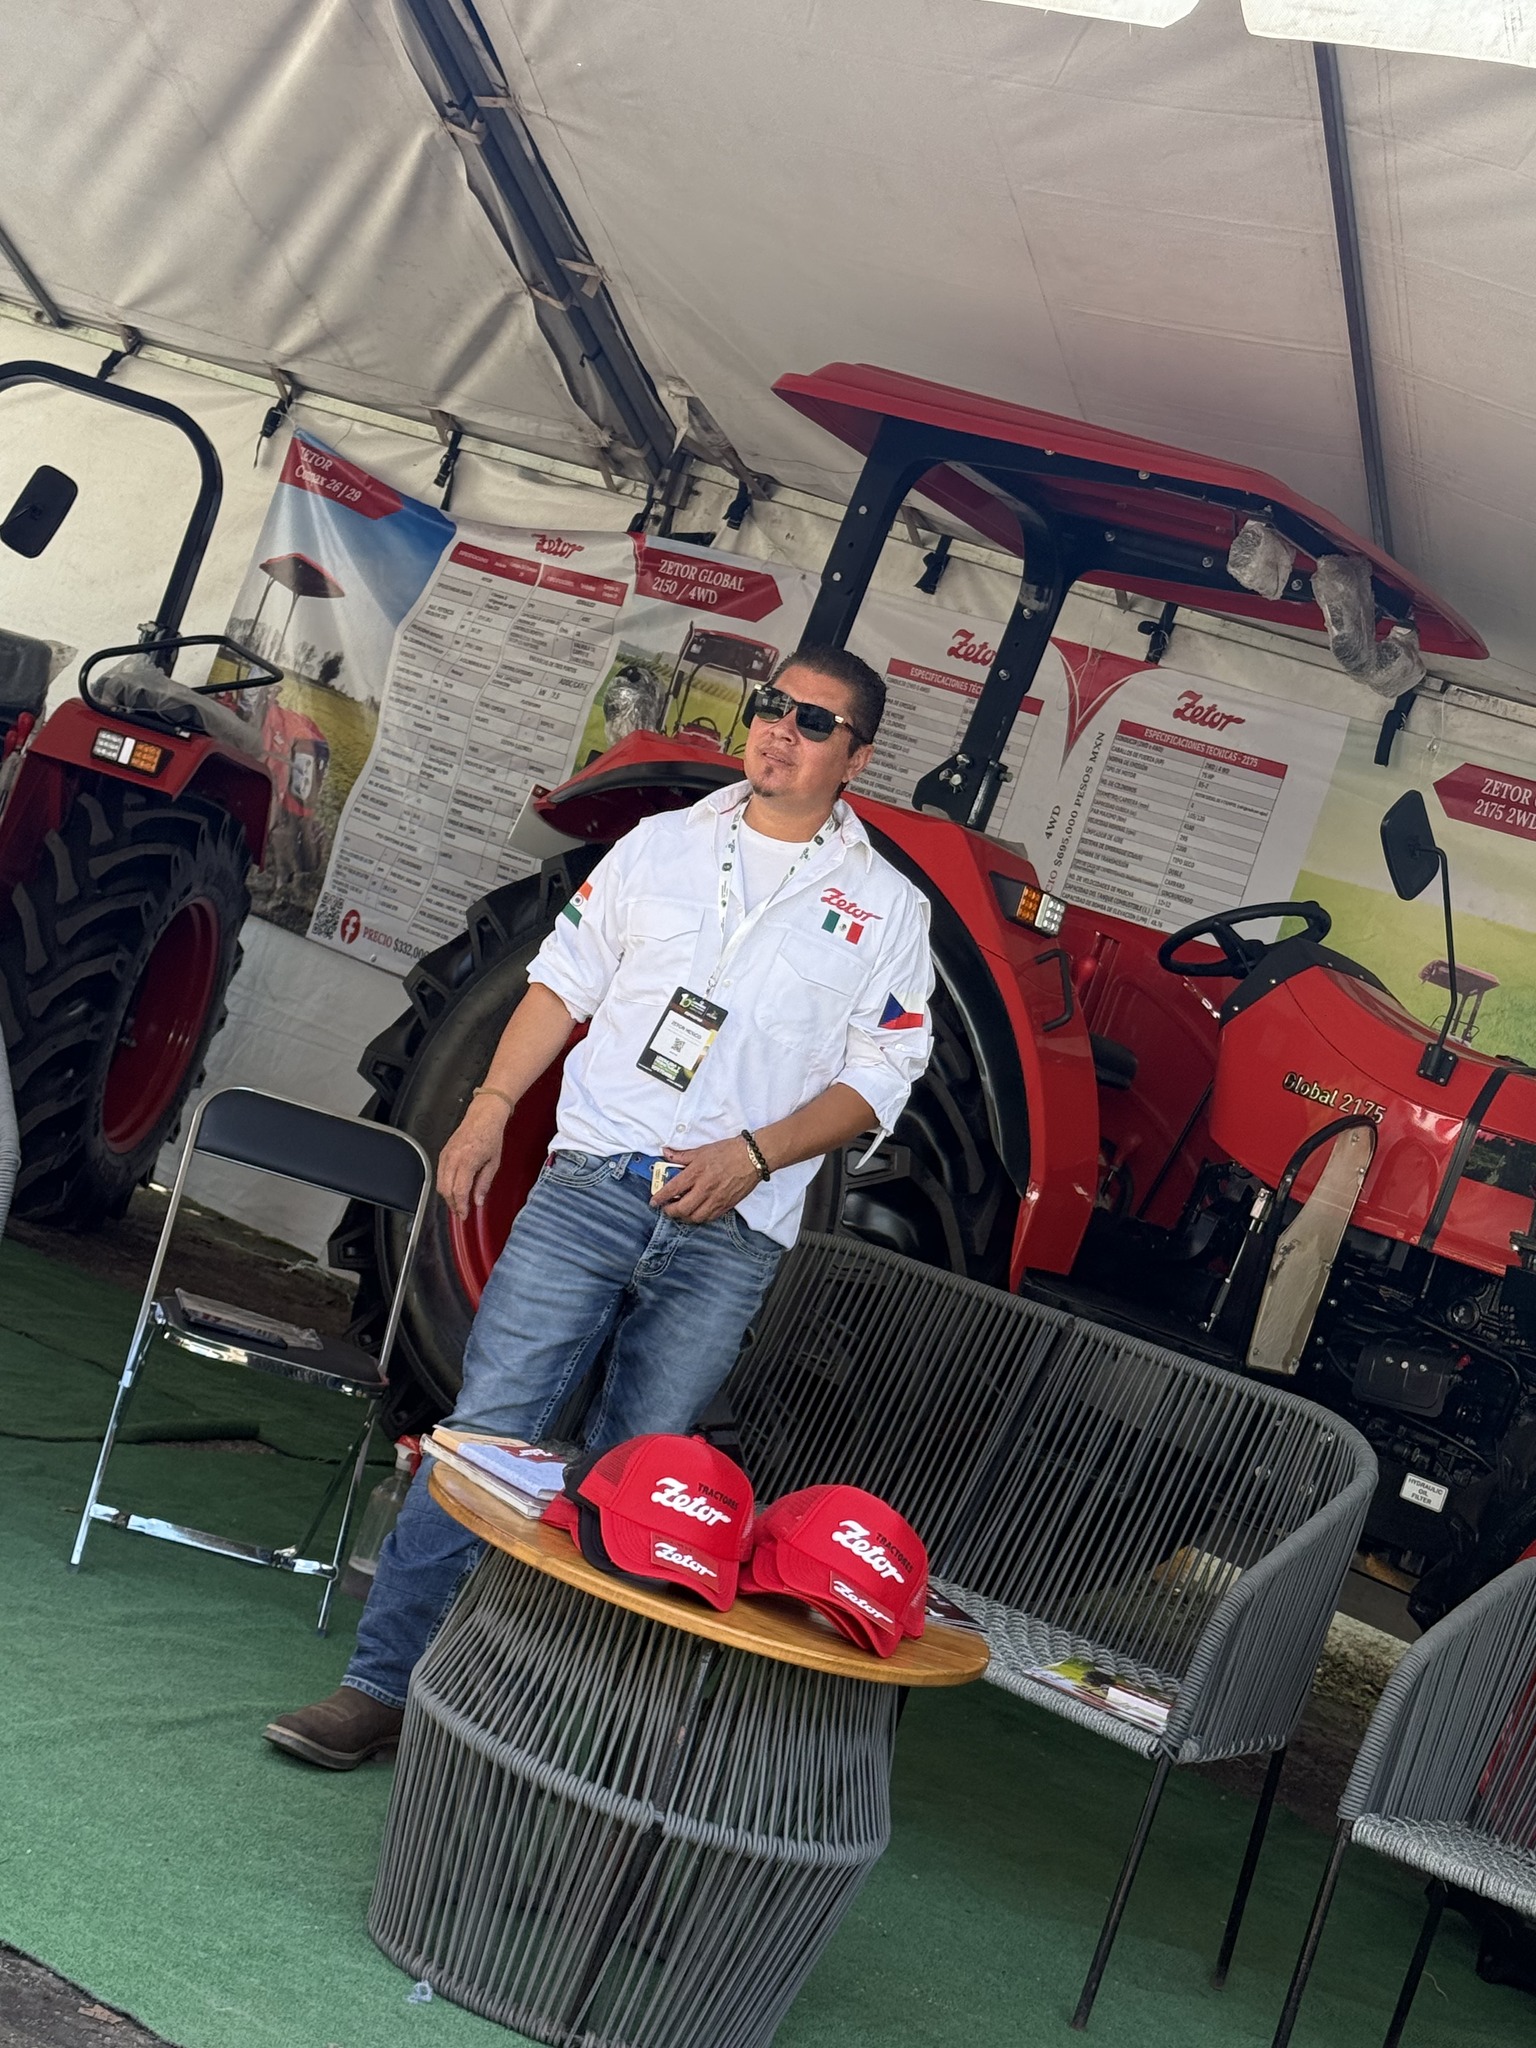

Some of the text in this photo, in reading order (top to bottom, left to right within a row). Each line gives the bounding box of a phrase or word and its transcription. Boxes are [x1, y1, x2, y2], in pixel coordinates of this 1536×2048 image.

[325, 479, 343, 494] 26
[345, 488, 362, 502] 29
[652, 576, 678, 595] 2150
[688, 585, 718, 605] 4WD
[658, 559, 746, 592] ZETOR GLOBAL
[946, 628, 997, 668] Zeto
[910, 666, 969, 693] ESPECIFICACIONES
[1172, 690, 1246, 732] Zetor
[1143, 727, 1205, 752] ESPECIFICACIONES
[1240, 755, 1259, 768] 2175
[1481, 778, 1533, 806] ZETOR
[1045, 732, 1106, 893] CIO $695,000 PESOS MXN
[1045, 805, 1061, 840] 4WD
[1474, 798, 1506, 821] 2175
[820, 888, 884, 922] Zetor
[362, 926, 393, 948] PRECIO
[1283, 1072, 1387, 1124] Global 2175
[650, 1476, 732, 1526] Zetor
[697, 1482, 738, 1512] TRACTORES
[1408, 1477, 1444, 1496] HYDRAULIC
[1410, 1492, 1432, 1504] FILTER
[1418, 1488, 1428, 1497] OIL
[654, 1542, 718, 1578] Zetor
[831, 1520, 904, 1584] Zetor
[875, 1532, 914, 1575] TRACTORES
[834, 1580, 894, 1625] Zetor
